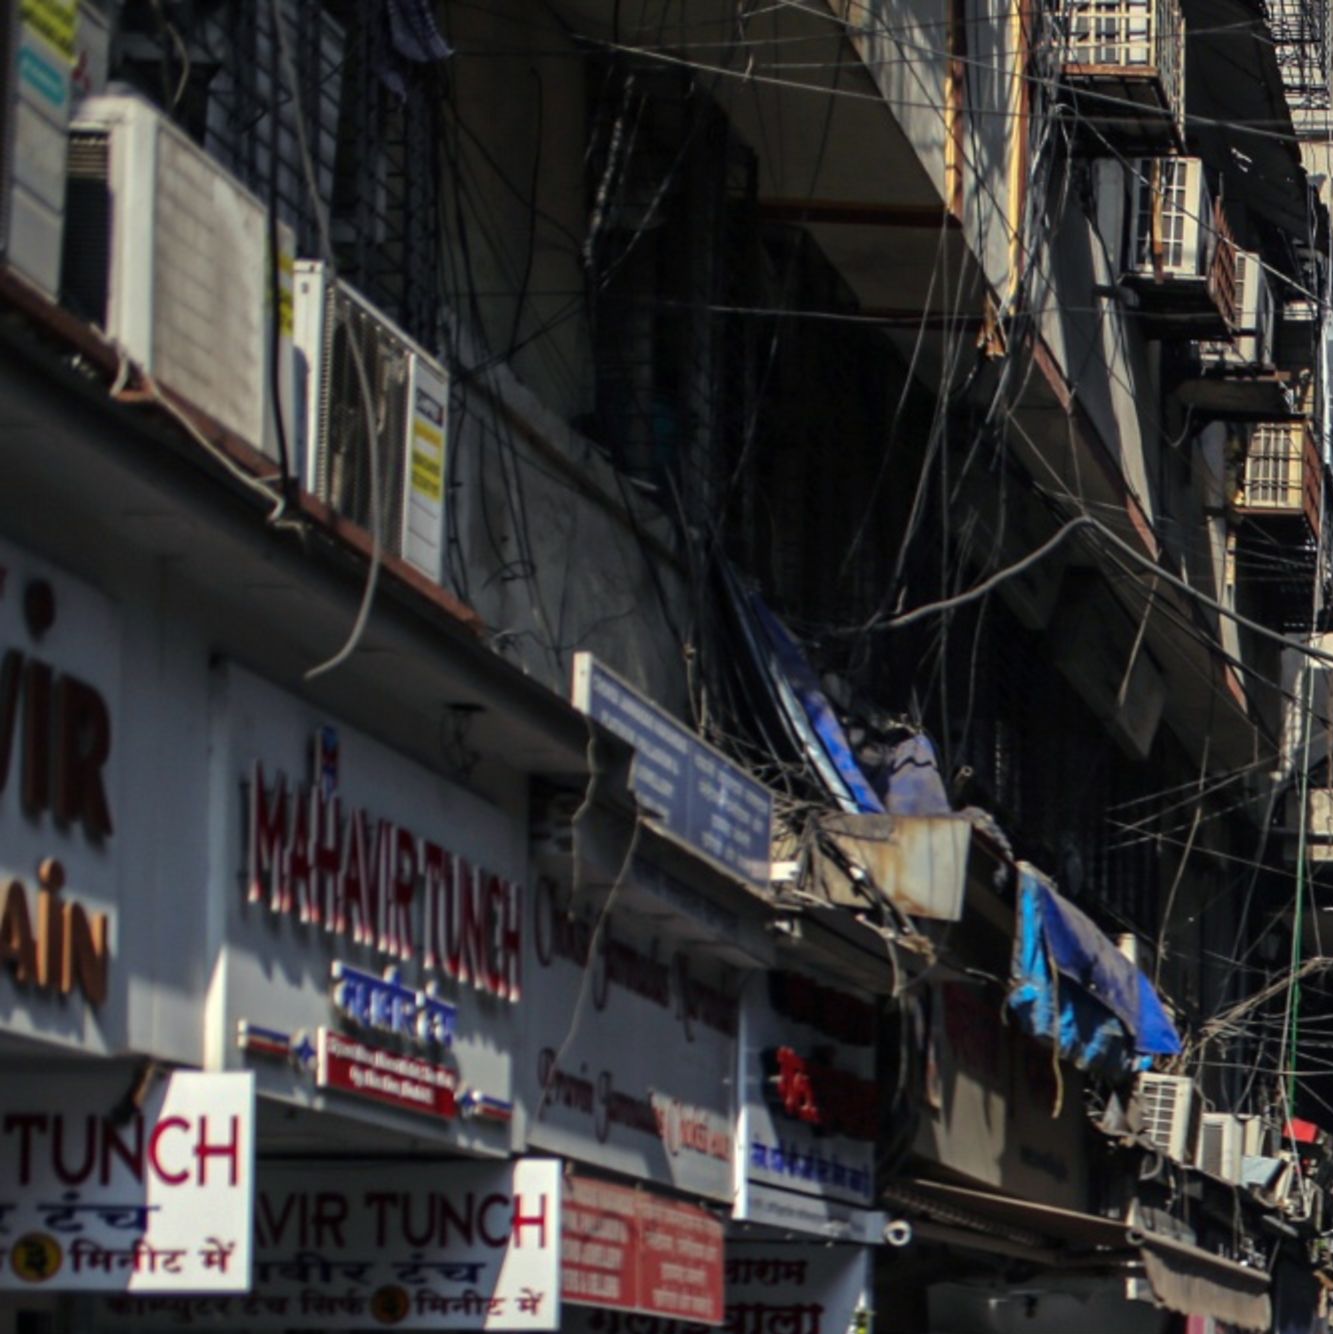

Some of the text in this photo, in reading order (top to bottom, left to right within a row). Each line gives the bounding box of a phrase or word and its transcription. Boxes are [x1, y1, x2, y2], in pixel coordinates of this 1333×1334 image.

[250, 757, 521, 1004] MAHAVIR TUNCH
[5, 1115, 239, 1186] TUNCH
[364, 1192, 547, 1248] TUNCH
[70, 1238, 187, 1273] मिनीट
[199, 1237, 235, 1273] में
[415, 1287, 506, 1316] मिनीट
[516, 1287, 544, 1316] में
